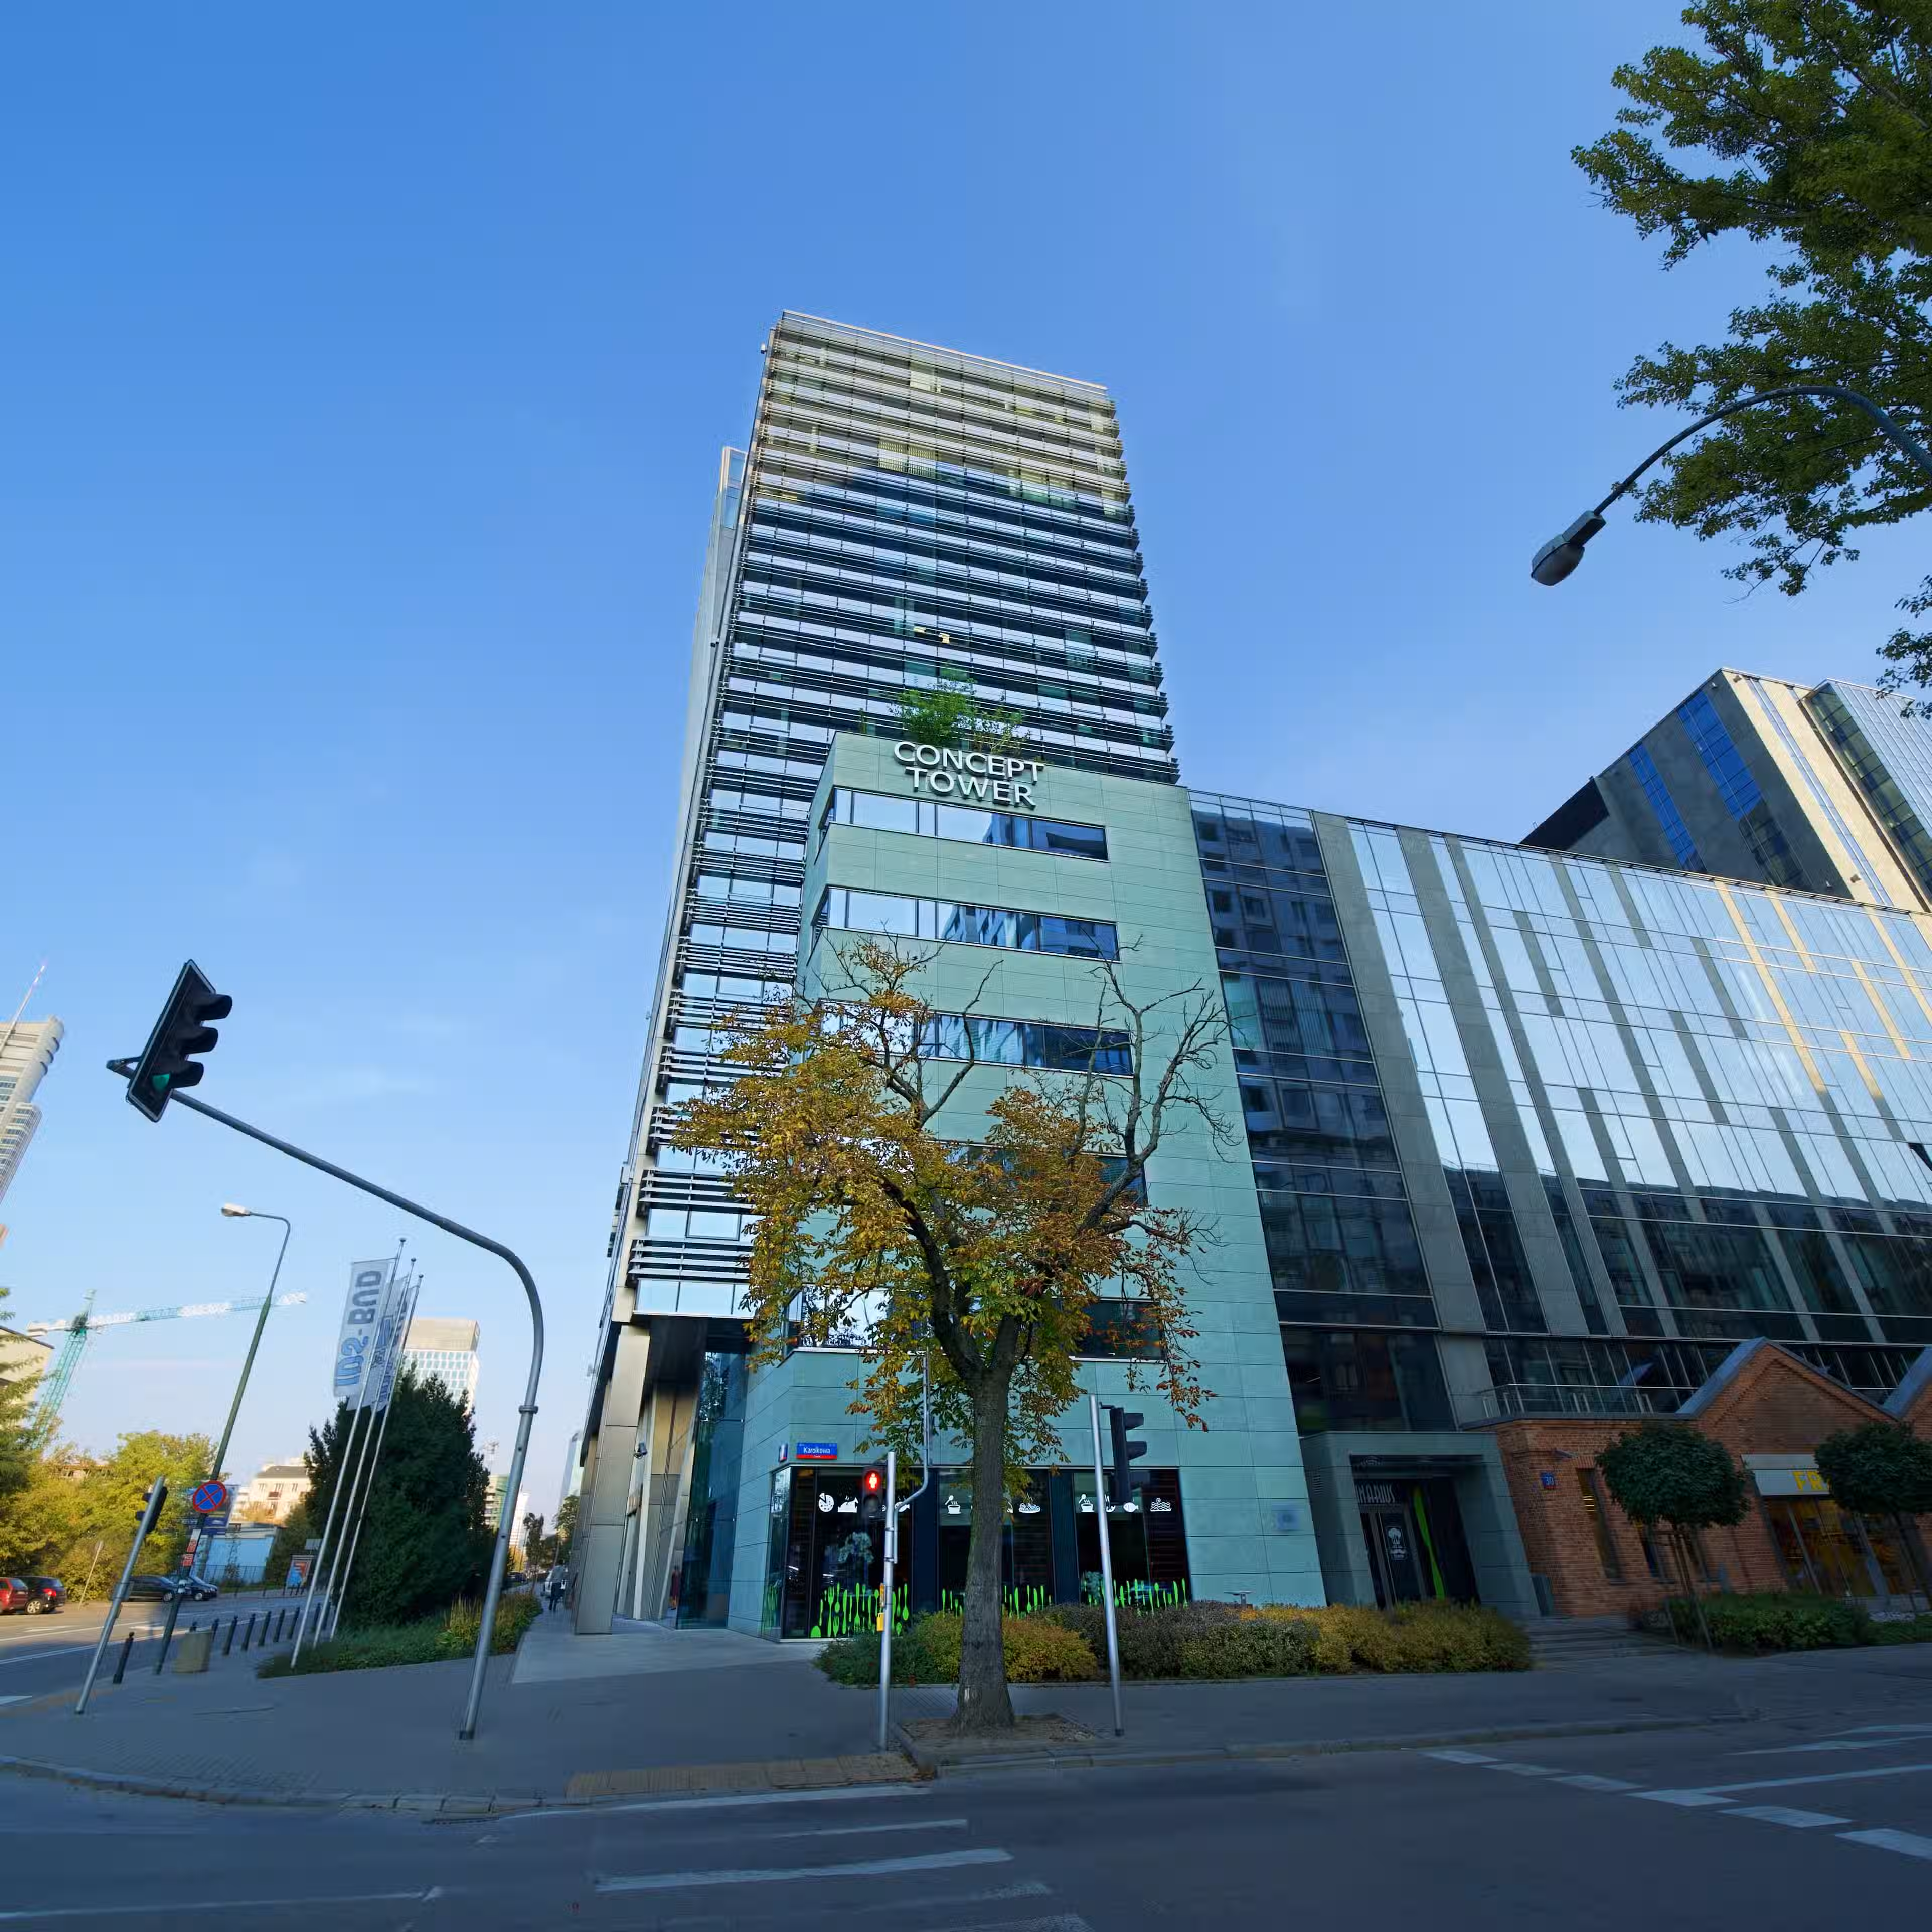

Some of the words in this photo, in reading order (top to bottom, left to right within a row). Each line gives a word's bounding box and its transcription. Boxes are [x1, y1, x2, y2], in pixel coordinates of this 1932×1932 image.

[894, 741, 1045, 785] CONCEPT
[905, 766, 1036, 810] TOWER
[1545, 1476, 1554, 1486] 30
